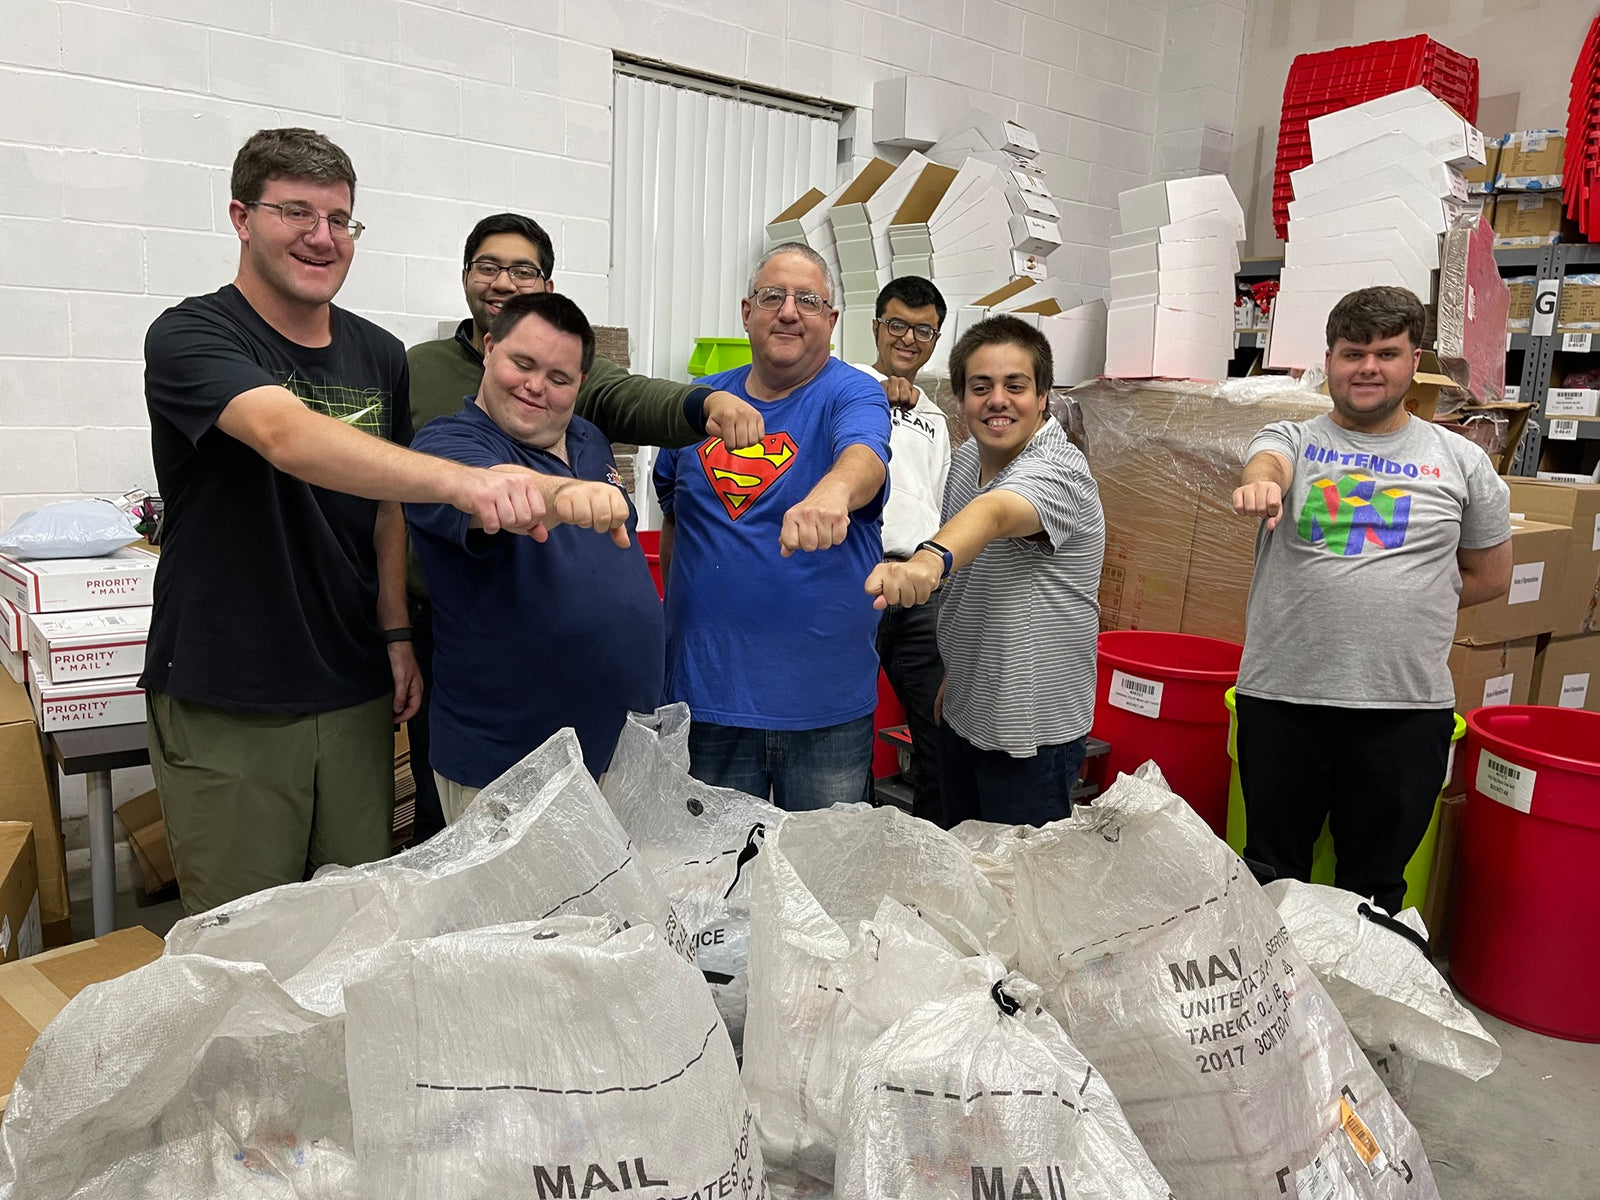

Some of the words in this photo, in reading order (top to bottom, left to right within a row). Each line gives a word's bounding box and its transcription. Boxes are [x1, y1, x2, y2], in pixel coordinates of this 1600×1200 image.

[1536, 291, 1557, 315] G
[1304, 443, 1419, 478] NINTENDO
[1420, 465, 1441, 479] 64
[86, 577, 139, 588] PRIORITY
[99, 587, 127, 596] MAIL
[54, 651, 115, 664] PRIORITY
[69, 662, 102, 672] MAIL
[46, 701, 109, 715] PRIORITY
[61, 712, 94, 722] MAIL
[1180, 990, 1243, 1020] UNITE
[1195, 1044, 1246, 1074] 2017
[533, 1157, 669, 1200] MAIL
